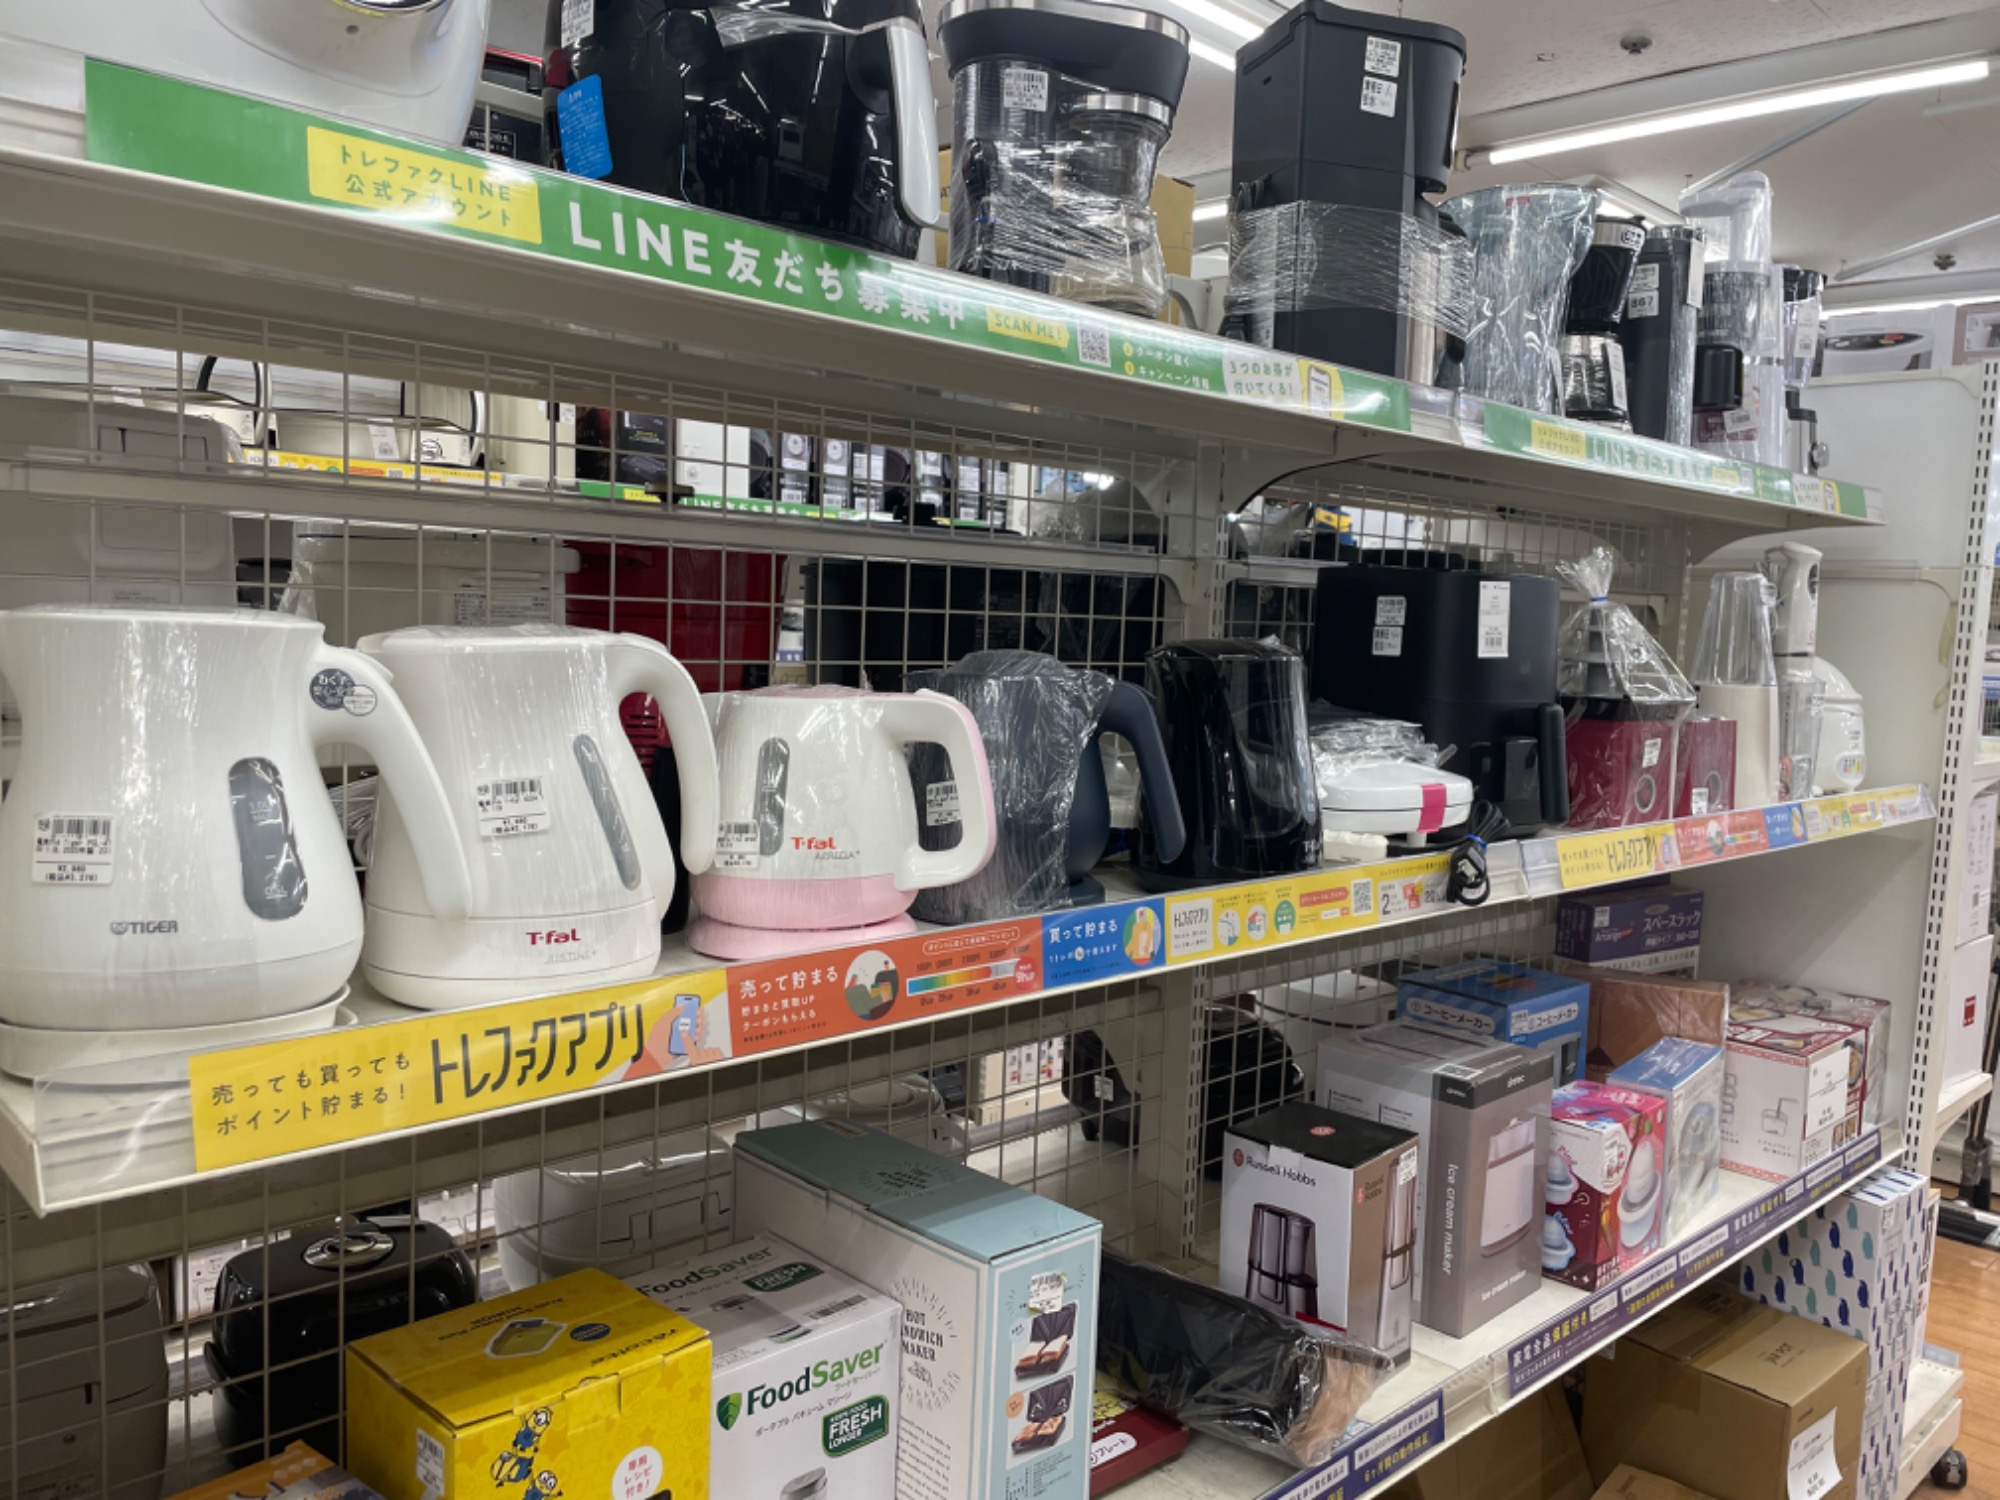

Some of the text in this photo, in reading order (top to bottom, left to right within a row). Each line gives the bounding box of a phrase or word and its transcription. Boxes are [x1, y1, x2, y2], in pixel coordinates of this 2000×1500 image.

[340, 144, 512, 202] トレファクLINE
[344, 173, 511, 227] 公式アカウント
[993, 316, 1034, 336] SCAN
[128, 920, 179, 934] TIGER
[525, 928, 582, 946] T-fal
[740, 966, 838, 999] 売って貯まる
[431, 1001, 644, 1105] トレファクアプリ
[211, 1052, 410, 1106] 売っても買っても
[217, 1082, 405, 1136] ポイント貯まる!
[1245, 1155, 1316, 1187] Russell Hobbs
[1445, 1187, 1456, 1230] cream
[905, 1309, 926, 1324] HOT
[747, 1342, 884, 1416] FoodSaver
[829, 1402, 883, 1439] FRESH
[829, 1428, 863, 1450] LONGER
[624, 1464, 653, 1486] レシピ
